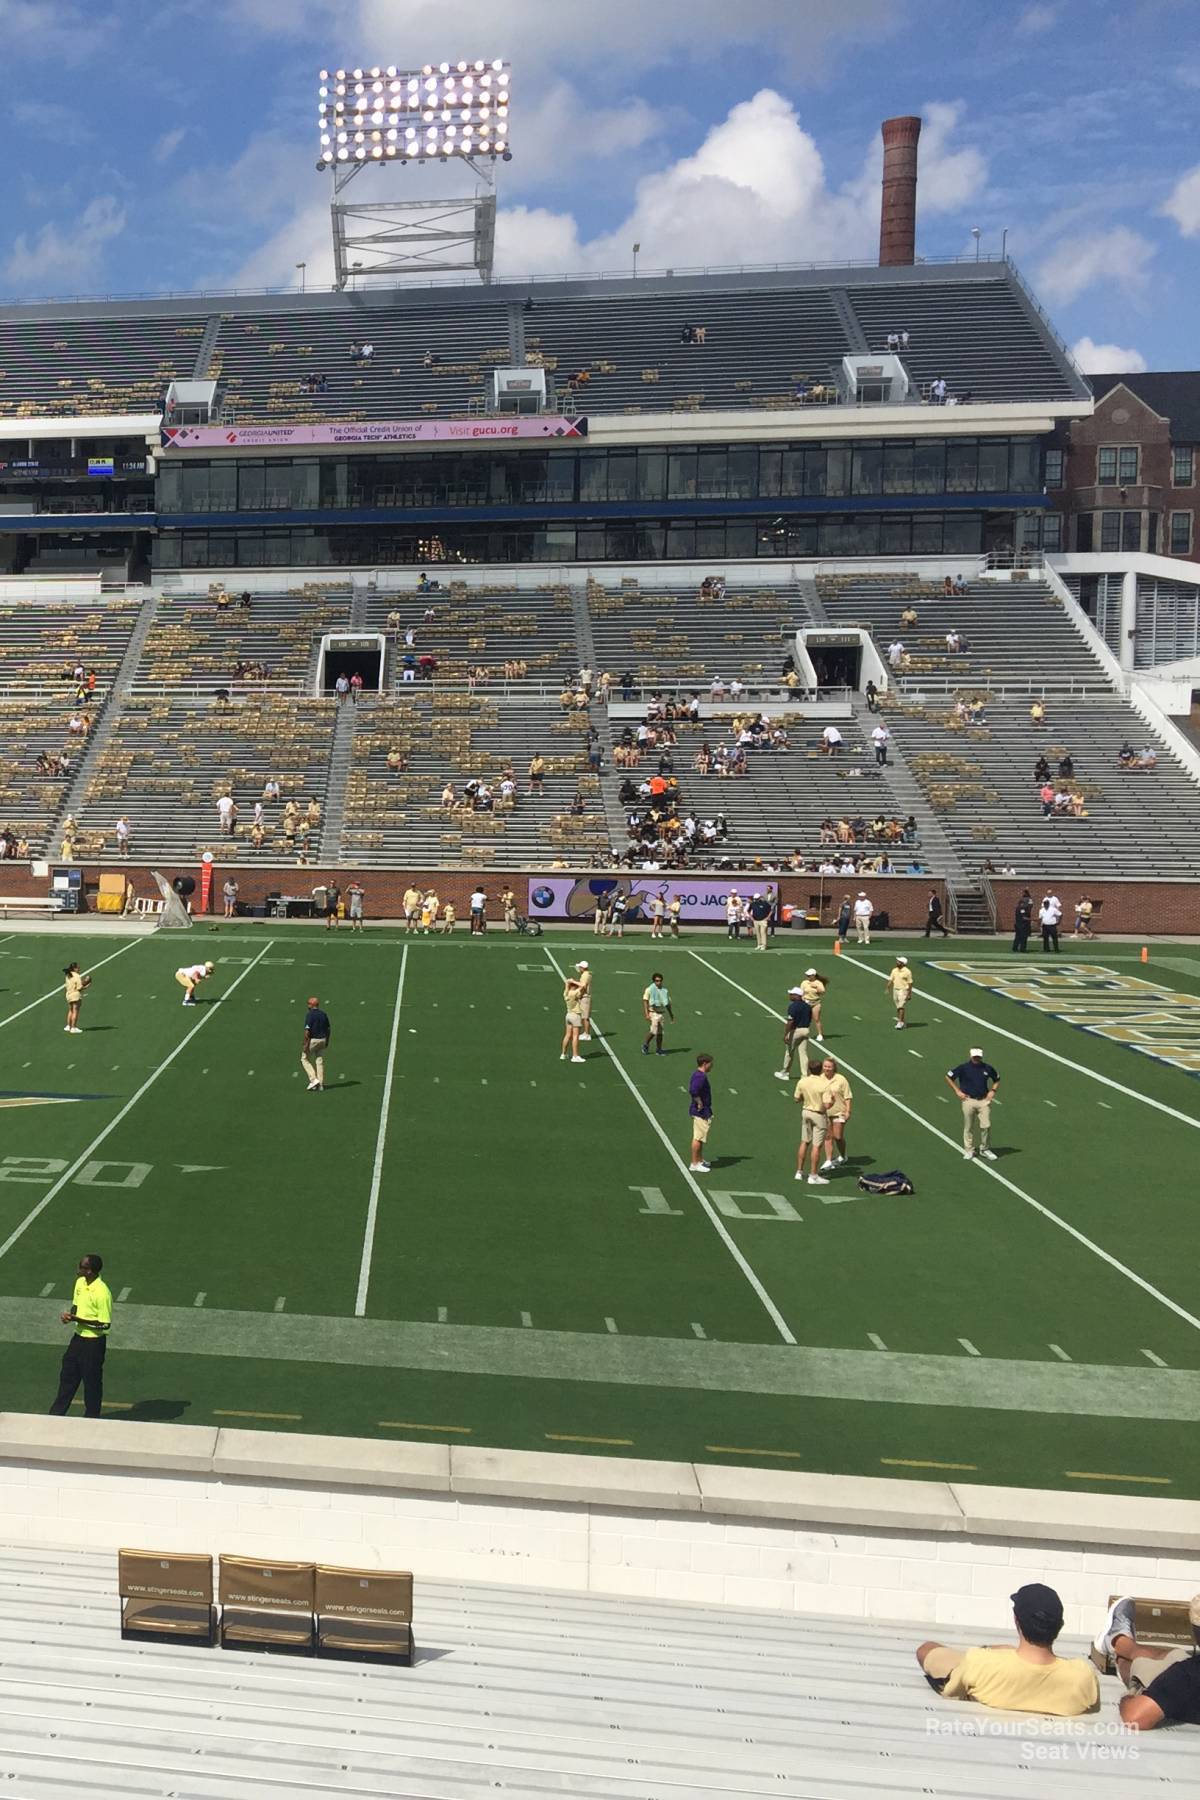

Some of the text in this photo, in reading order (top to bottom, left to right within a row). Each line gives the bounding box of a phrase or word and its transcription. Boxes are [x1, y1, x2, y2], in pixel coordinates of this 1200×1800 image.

[369, 425, 390, 433] Credit
[449, 425, 519, 437] Visit gucu.org
[628, 1185, 804, 1222] 10
[127, 1584, 204, 1598] www.stingerseats.com
[228, 1592, 310, 1607] www.stingerseats.com
[325, 1602, 405, 1617] www.stingerseats.com
